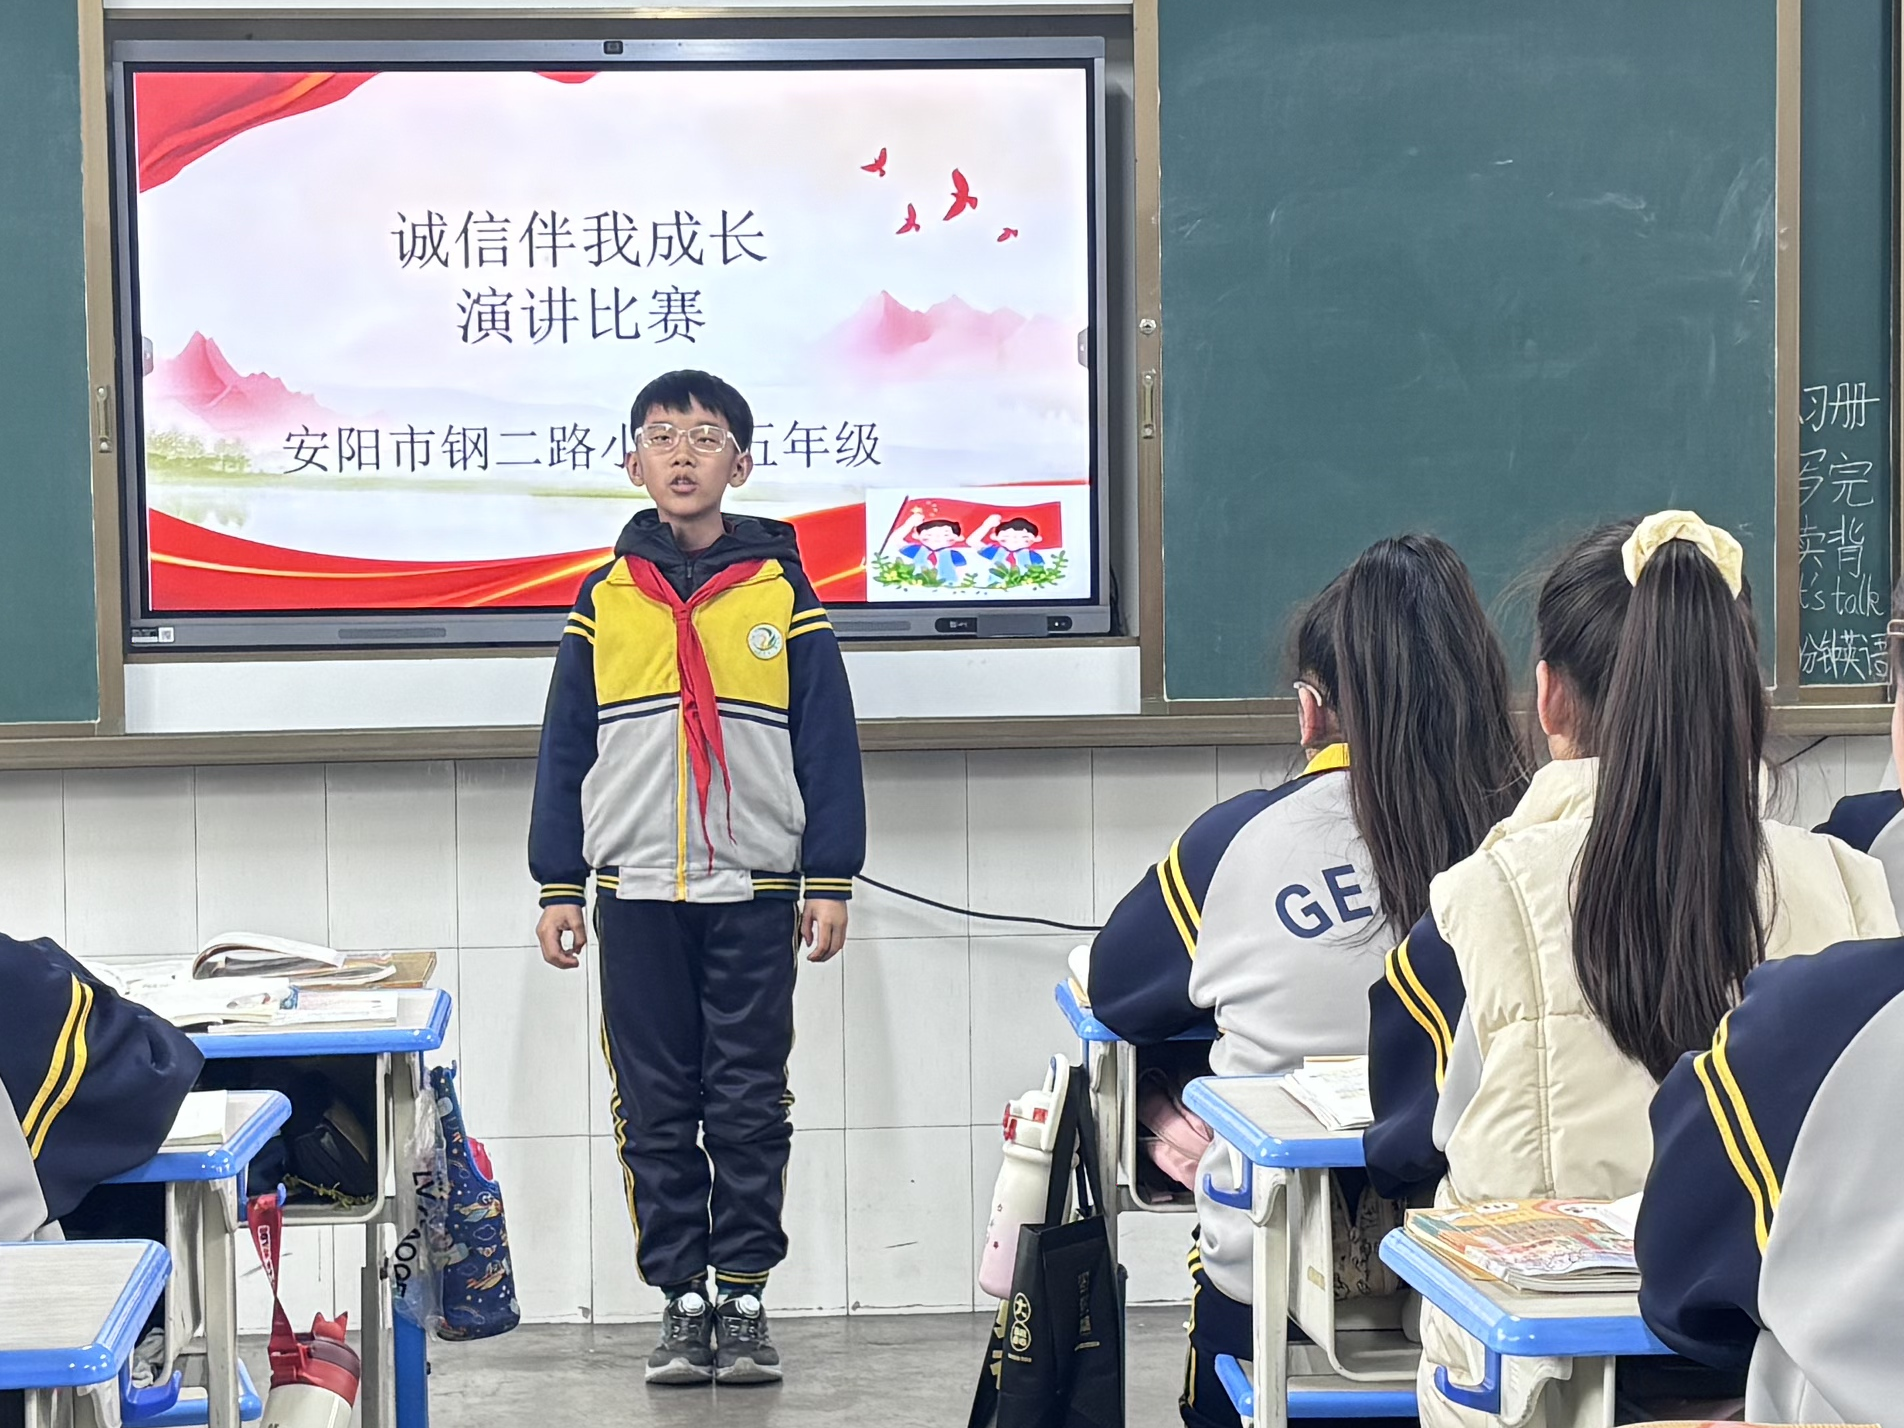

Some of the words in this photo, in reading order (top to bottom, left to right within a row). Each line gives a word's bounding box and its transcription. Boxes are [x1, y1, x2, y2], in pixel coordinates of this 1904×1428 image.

[391, 208, 768, 270] 诚信伴我成长
[458, 286, 707, 345] 演讲比赛
[1799, 382, 1880, 432] 习册
[1831, 573, 1885, 617] talk
